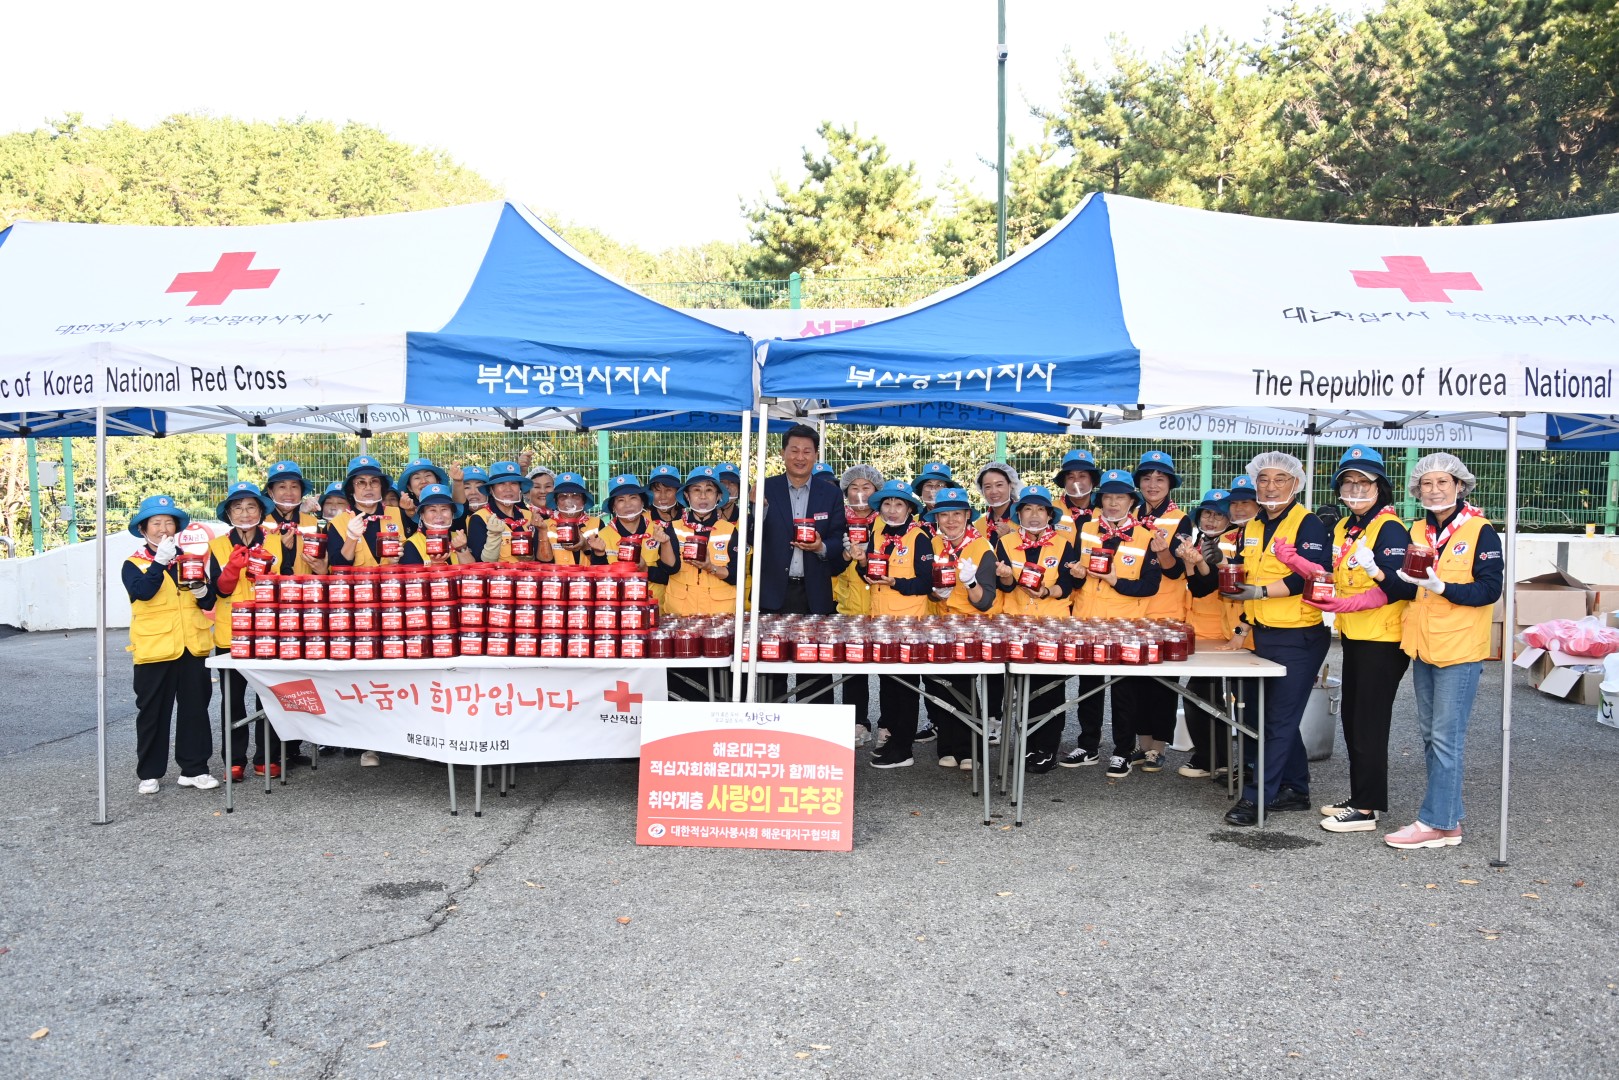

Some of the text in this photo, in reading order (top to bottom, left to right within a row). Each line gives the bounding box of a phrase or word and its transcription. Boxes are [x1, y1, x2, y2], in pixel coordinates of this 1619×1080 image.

[14, 371, 31, 397] of
[43, 370, 94, 396] Korea
[106, 366, 181, 393] National
[190, 365, 228, 392] Red
[234, 364, 288, 391] Cross
[476, 363, 671, 396] 부산광역시지사
[1252, 366, 1612, 403] The Republic of Korea National
[335, 680, 580, 717] 나눔이 희망입니다
[600, 714, 642, 725] 부산적십
[406, 733, 510, 753] 해운대지구 적십자봉사회
[712, 742, 781, 759] 해운대구청
[650, 760, 844, 781] 적십자회해운대지구가 함께하는
[648, 784, 844, 815] 취약계층 사랑의 고추장
[670, 825, 841, 842] 대한적십자사봉사회 해운대지구협의회
